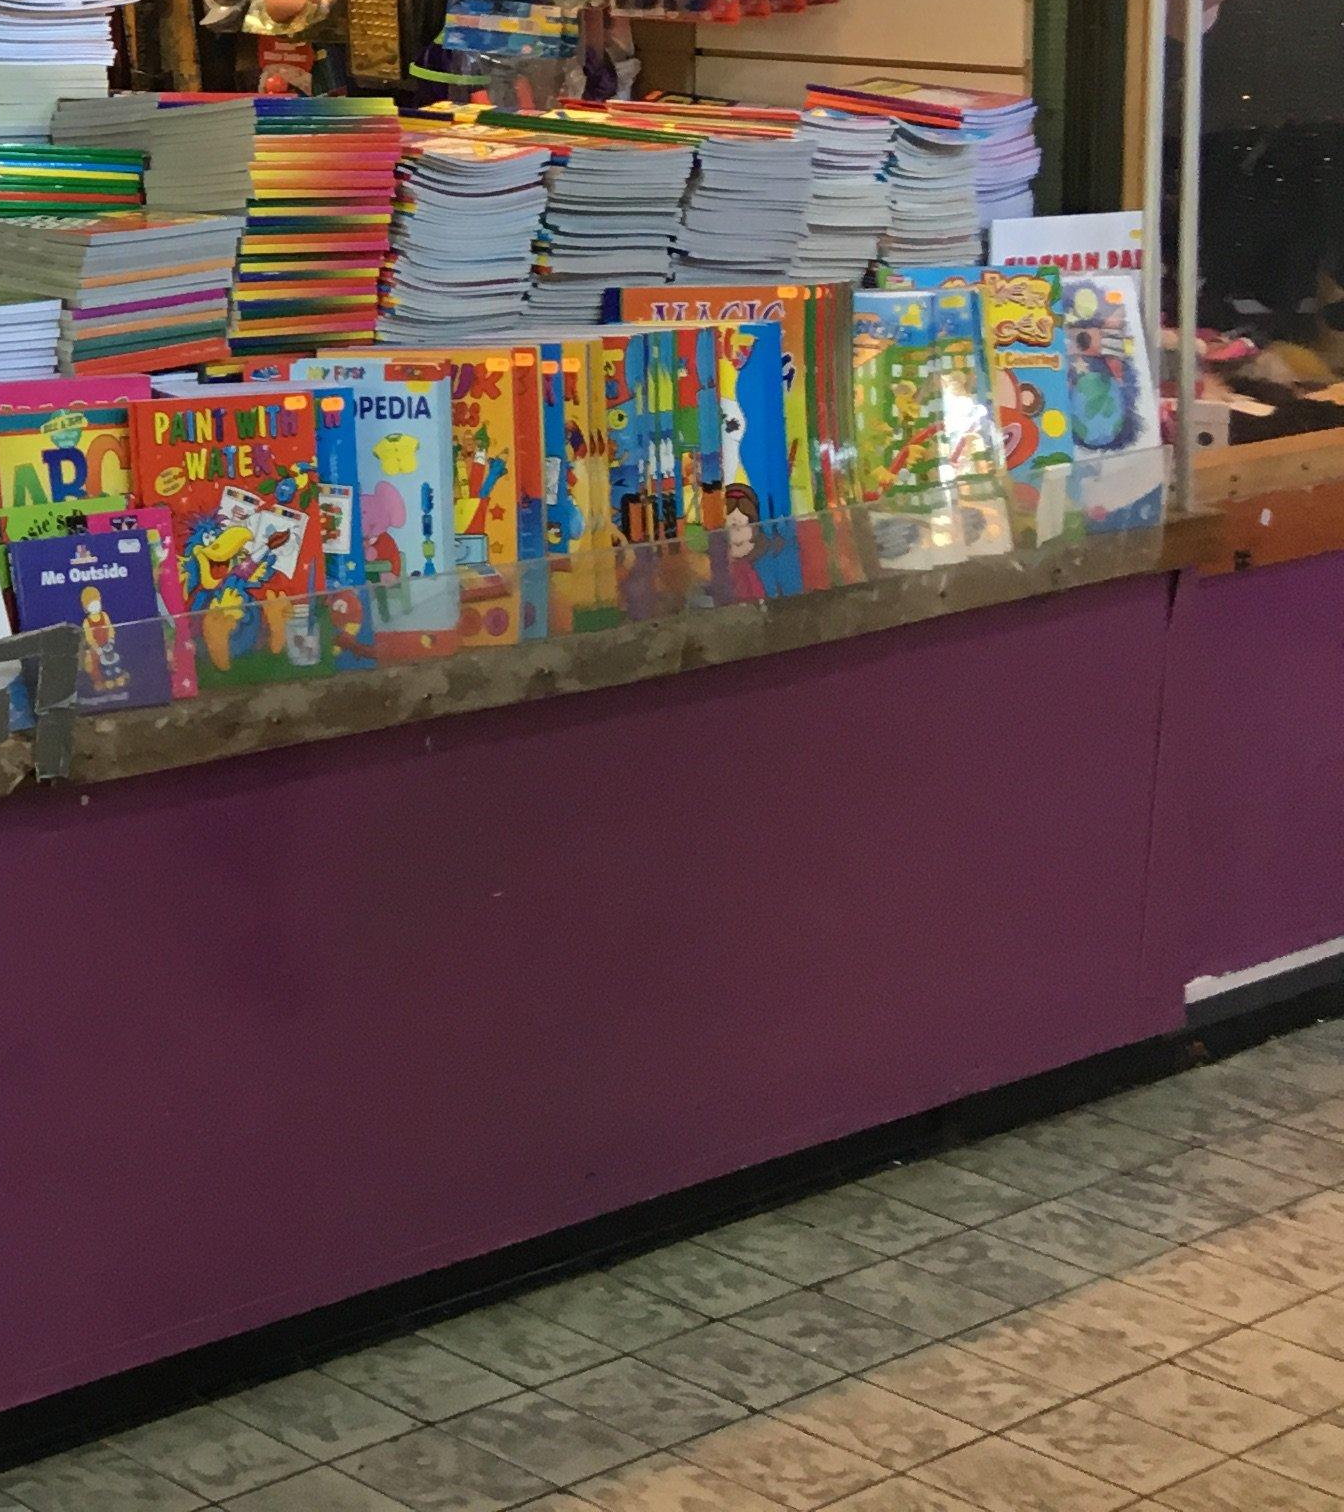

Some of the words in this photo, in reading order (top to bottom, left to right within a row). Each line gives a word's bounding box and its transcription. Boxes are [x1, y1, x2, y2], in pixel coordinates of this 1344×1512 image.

[352, 395, 432, 421] PEDIA
[154, 407, 227, 445] PAINT
[184, 444, 274, 482] WATER
[40, 570, 66, 586] Me
[68, 562, 129, 583] Outside
